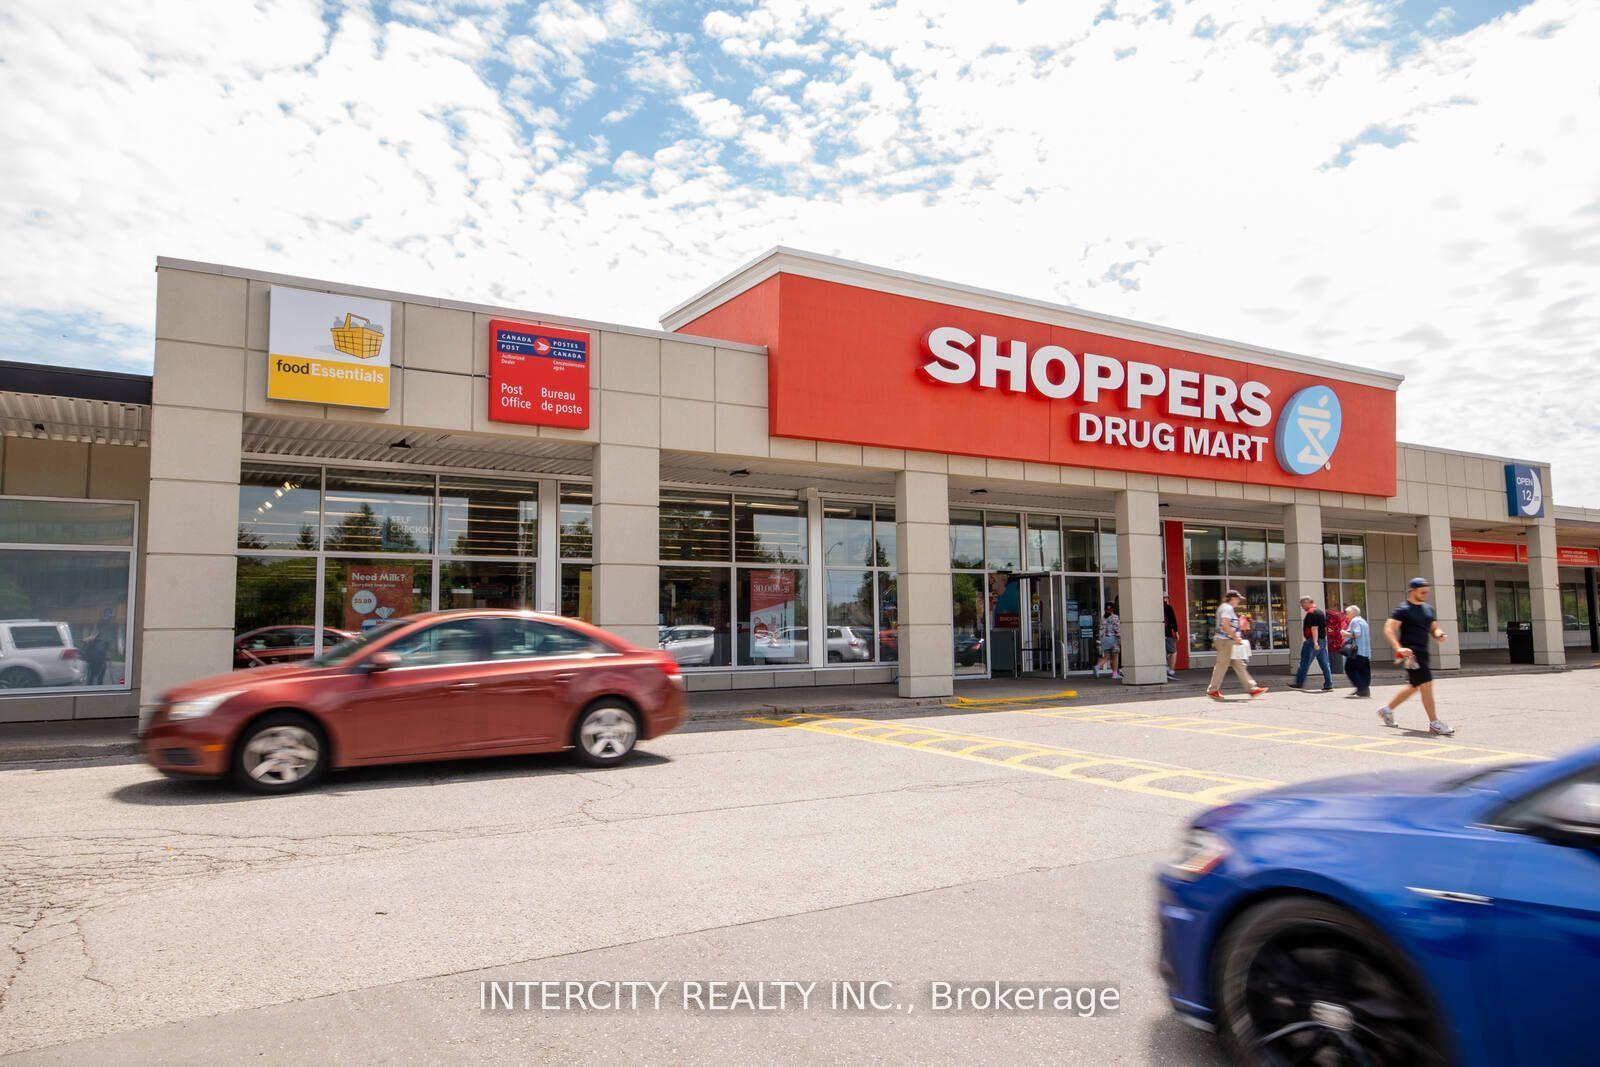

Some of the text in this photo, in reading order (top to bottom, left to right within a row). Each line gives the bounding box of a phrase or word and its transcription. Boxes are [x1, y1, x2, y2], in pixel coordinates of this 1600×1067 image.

[501, 333, 532, 343] CANADA
[553, 340, 579, 349] POSTES
[553, 351, 582, 359] CANADA
[276, 359, 384, 383] food Essentials
[923, 326, 1272, 427] SHOPPERS
[501, 382, 523, 395] Post
[541, 387, 576, 401] Bureau
[501, 396, 532, 409] Office
[541, 400, 583, 415] de poste
[1078, 412, 1269, 462] DRUG MART
[1516, 476, 1533, 486] OPEN
[1522, 489, 1532, 501] 12
[351, 572, 406, 582] Need Milk?
